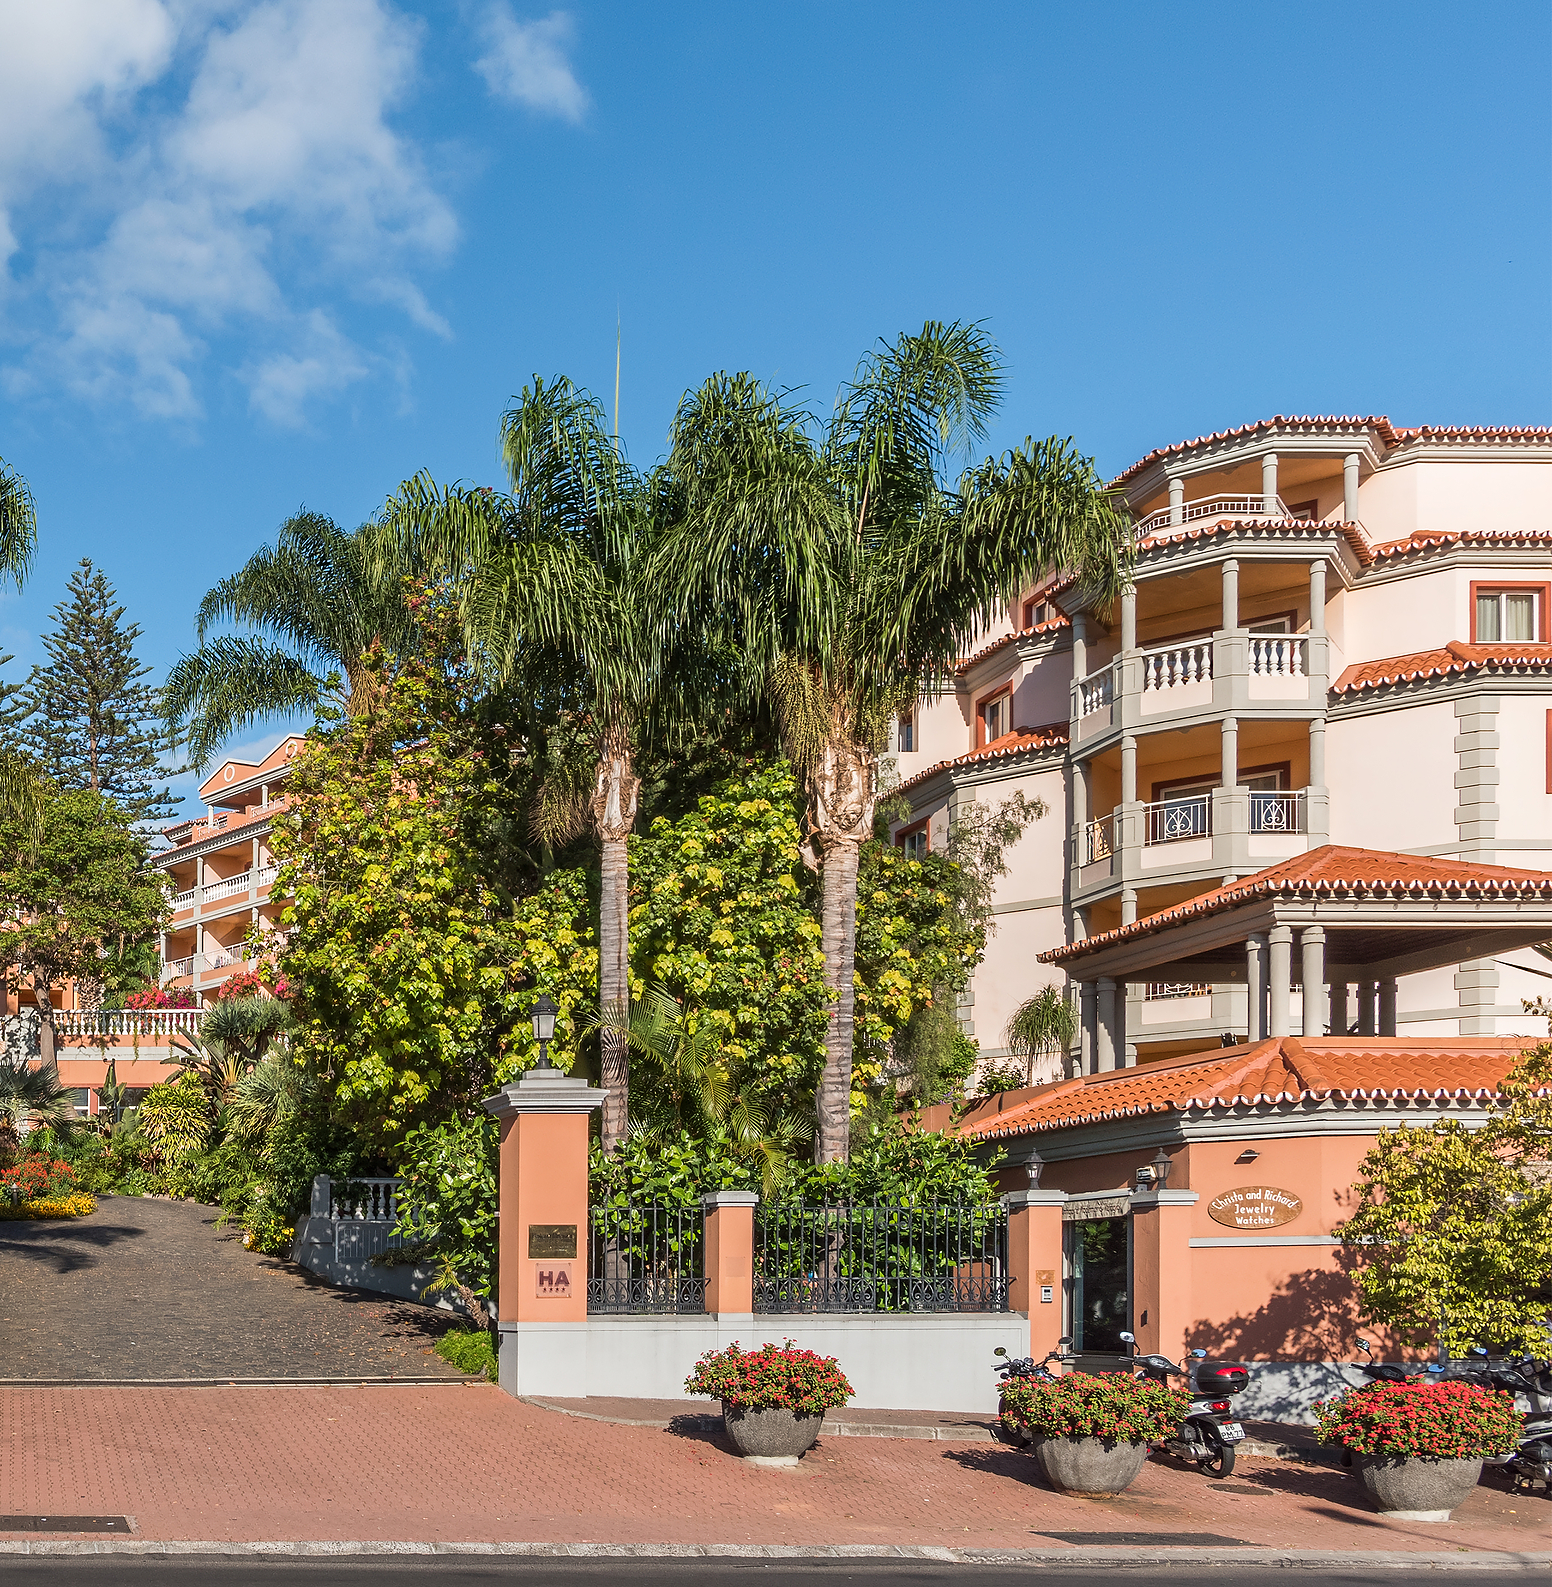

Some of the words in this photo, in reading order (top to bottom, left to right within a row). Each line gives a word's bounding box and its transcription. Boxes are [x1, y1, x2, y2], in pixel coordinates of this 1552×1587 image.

[1212, 1191, 1244, 1210] Christa
[1245, 1189, 1262, 1200] and
[1264, 1189, 1299, 1209] Richard
[1234, 1203, 1275, 1216] Jewelry
[1235, 1215, 1275, 1225] Watches
[539, 1270, 570, 1287] HA
